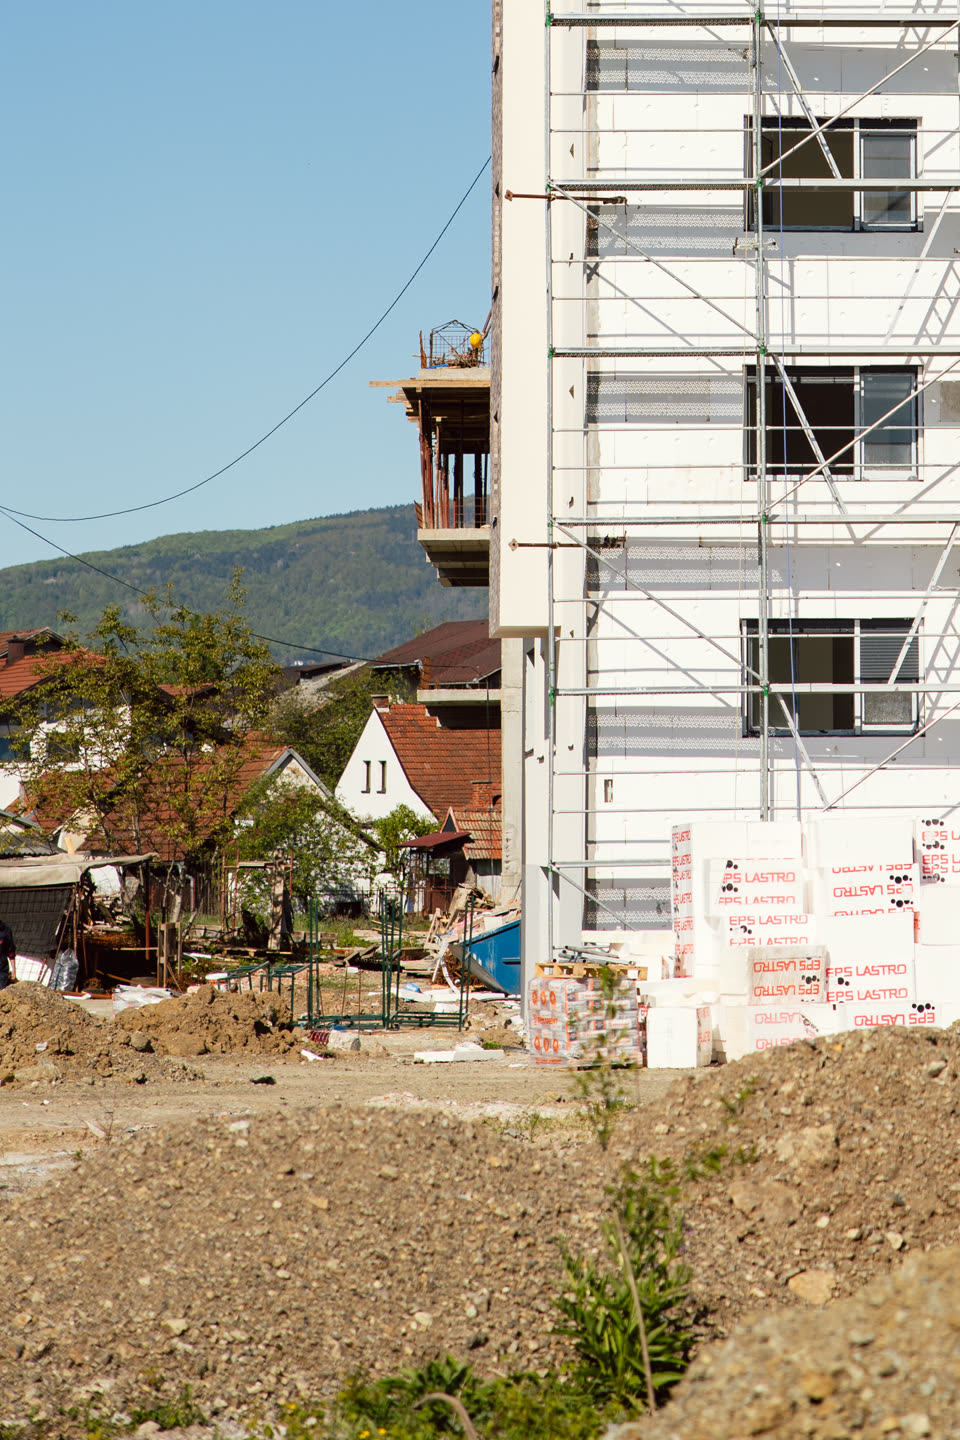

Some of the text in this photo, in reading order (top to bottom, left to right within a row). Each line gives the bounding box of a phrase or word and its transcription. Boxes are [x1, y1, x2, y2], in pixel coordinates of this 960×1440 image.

[922, 854, 948, 864] EPS
[745, 872, 796, 883] LASTRO
[833, 885, 883, 897] LASTRO
[729, 914, 808, 926] EPS LASTRO
[753, 960, 821, 973] EPS LASTRO
[856, 964, 907, 976] LASTRO
[753, 983, 820, 997] EPS LASTRO
[827, 988, 908, 1002] EPS LASTRO
[854, 1012, 935, 1026] EPS LASTRO
